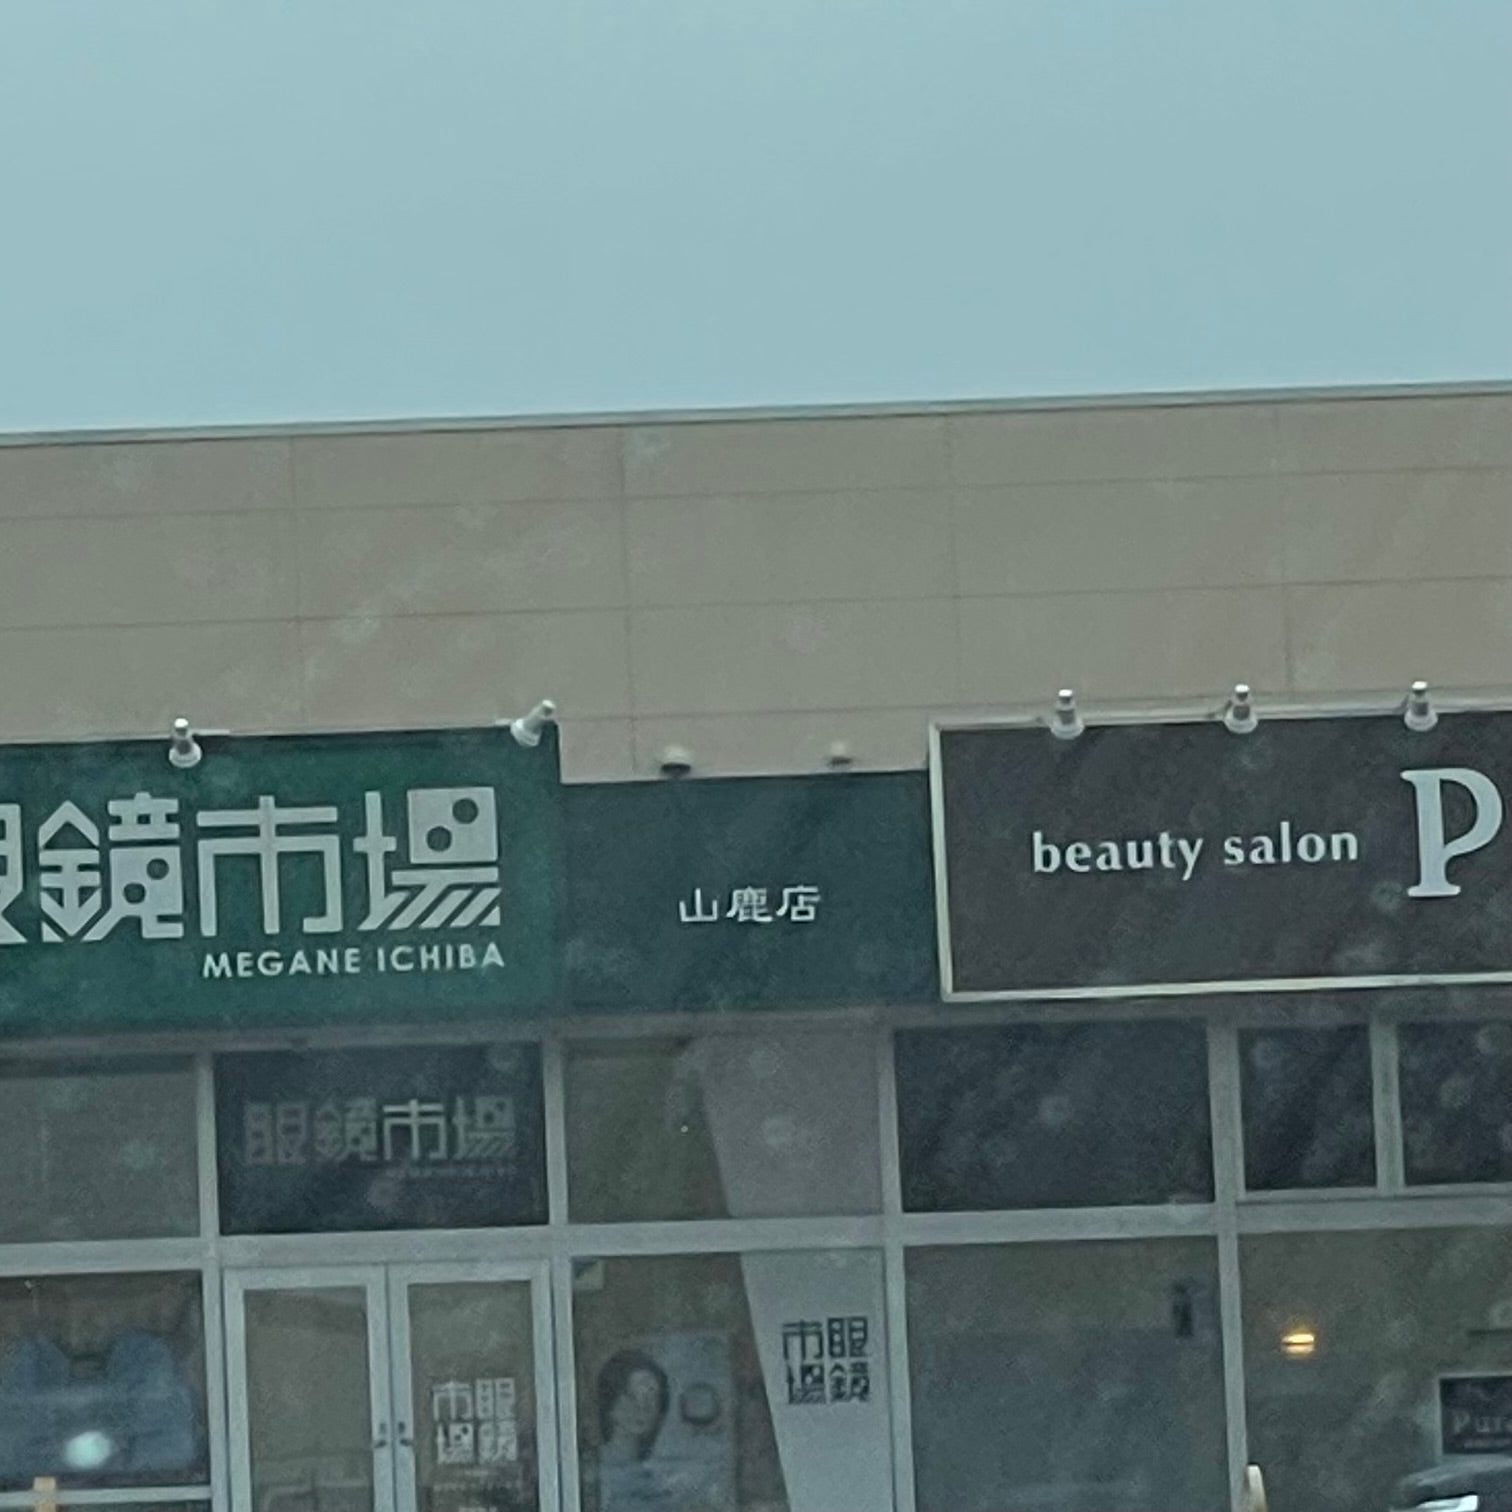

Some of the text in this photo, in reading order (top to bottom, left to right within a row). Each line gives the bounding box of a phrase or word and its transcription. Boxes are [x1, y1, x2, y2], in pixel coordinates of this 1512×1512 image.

[1032, 821, 1358, 881] beauty salon
[1400, 767, 1503, 898] P
[679, 885, 822, 923] 山鹿店
[202, 941, 505, 979] MEGANE ICHIBA
[244, 1095, 517, 1166] 眼鏡市場
